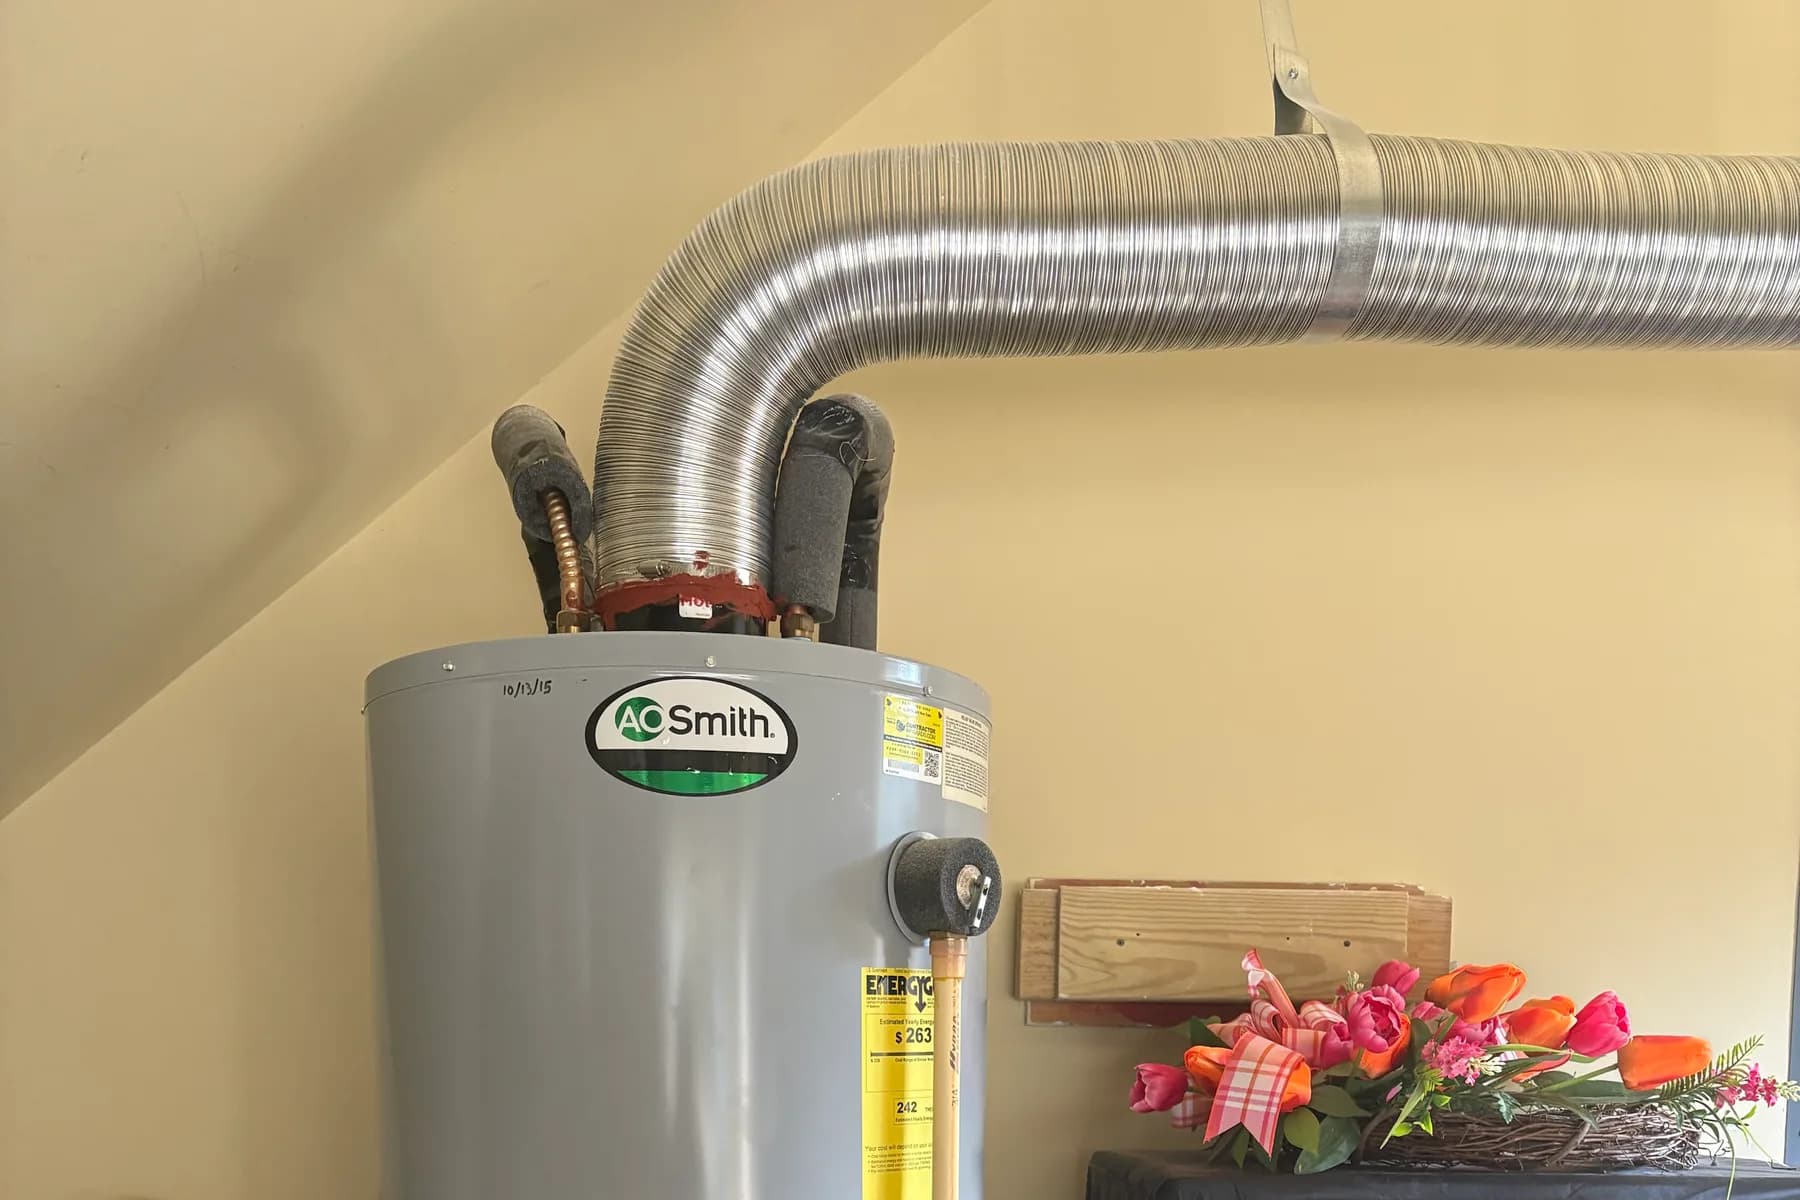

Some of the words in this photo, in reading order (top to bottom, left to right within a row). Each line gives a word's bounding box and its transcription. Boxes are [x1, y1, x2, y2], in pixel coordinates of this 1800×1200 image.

[503, 677, 552, 699] 10/13/15
[669, 704, 770, 739] Smith
[865, 974, 935, 996] ENERGYG
[896, 1031, 902, 1044] $
[906, 1026, 932, 1044] 263
[896, 1101, 918, 1114] 242
